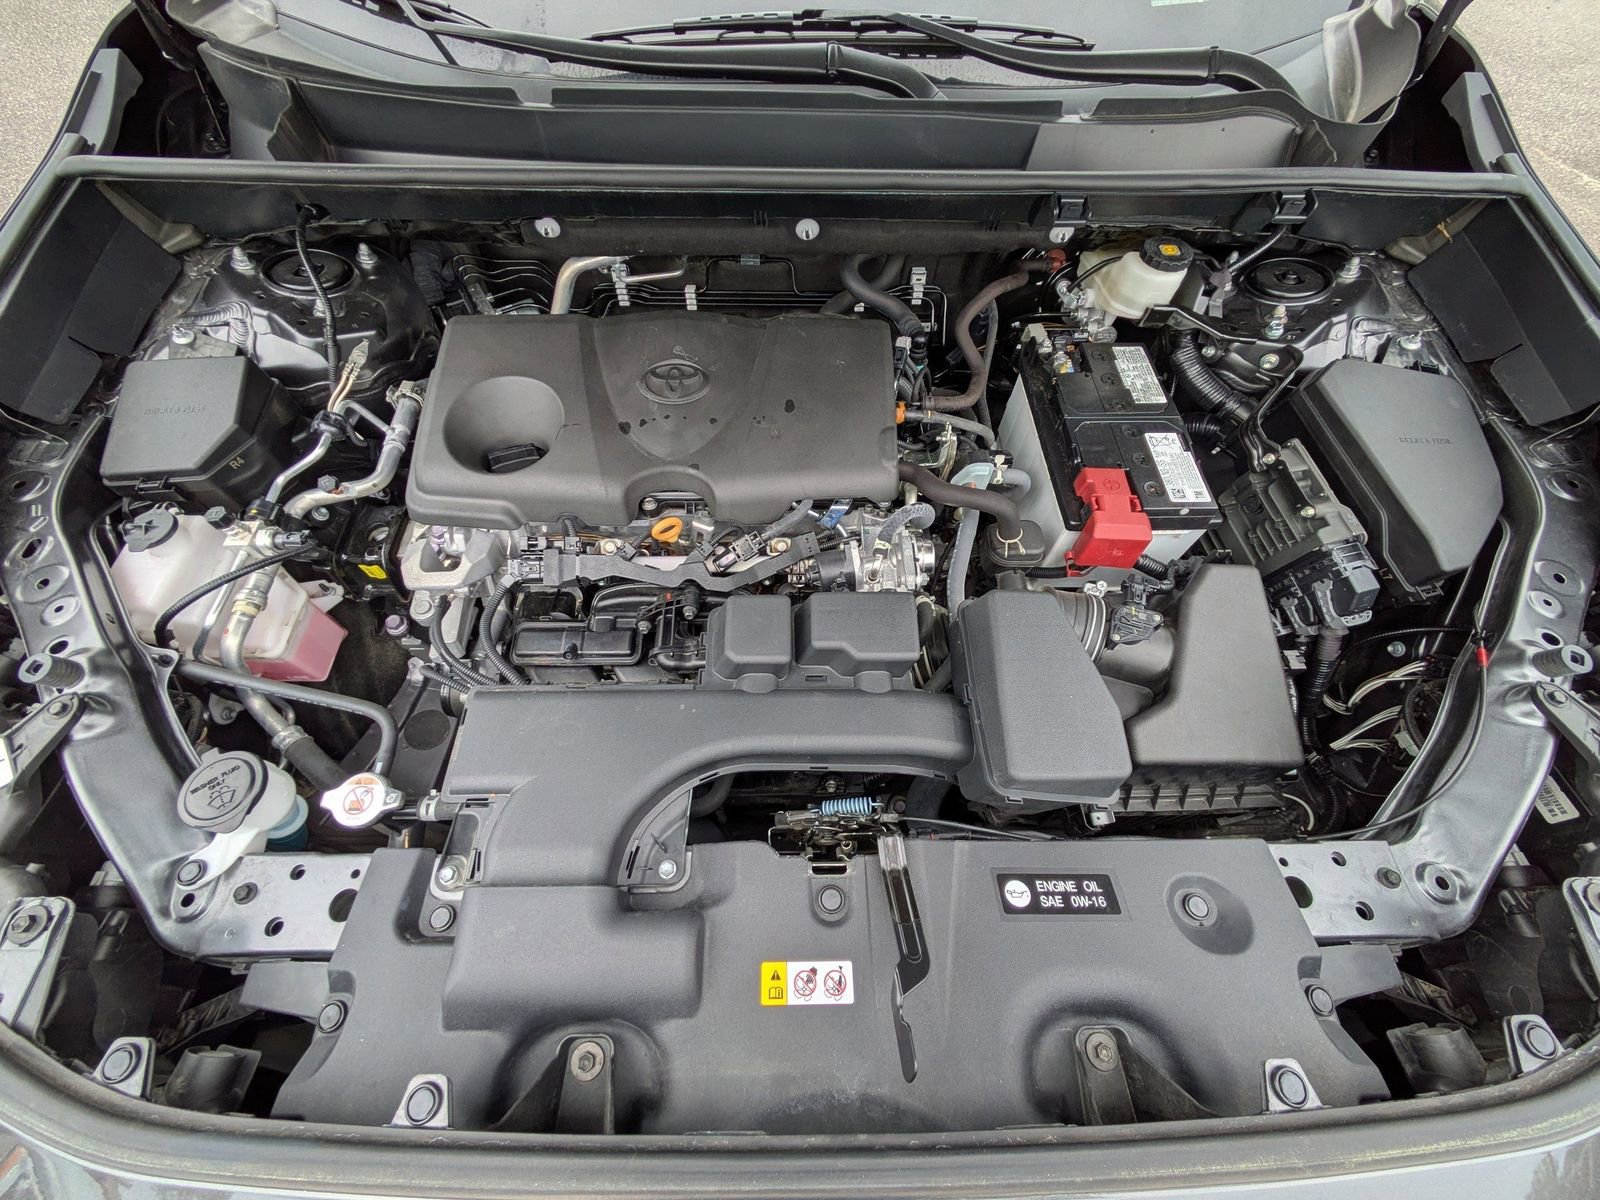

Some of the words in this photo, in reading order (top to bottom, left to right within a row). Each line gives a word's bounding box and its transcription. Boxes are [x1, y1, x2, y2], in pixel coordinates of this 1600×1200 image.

[229, 456, 246, 470] R4
[190, 776, 219, 795] WASHER
[221, 764, 241, 778] FLUID
[208, 778, 225, 791] ONLY
[1035, 880, 1078, 892] ENGINE
[1083, 880, 1103, 892] OIL
[1040, 895, 1064, 908] SAE
[1071, 895, 1107, 908] 0W-16
